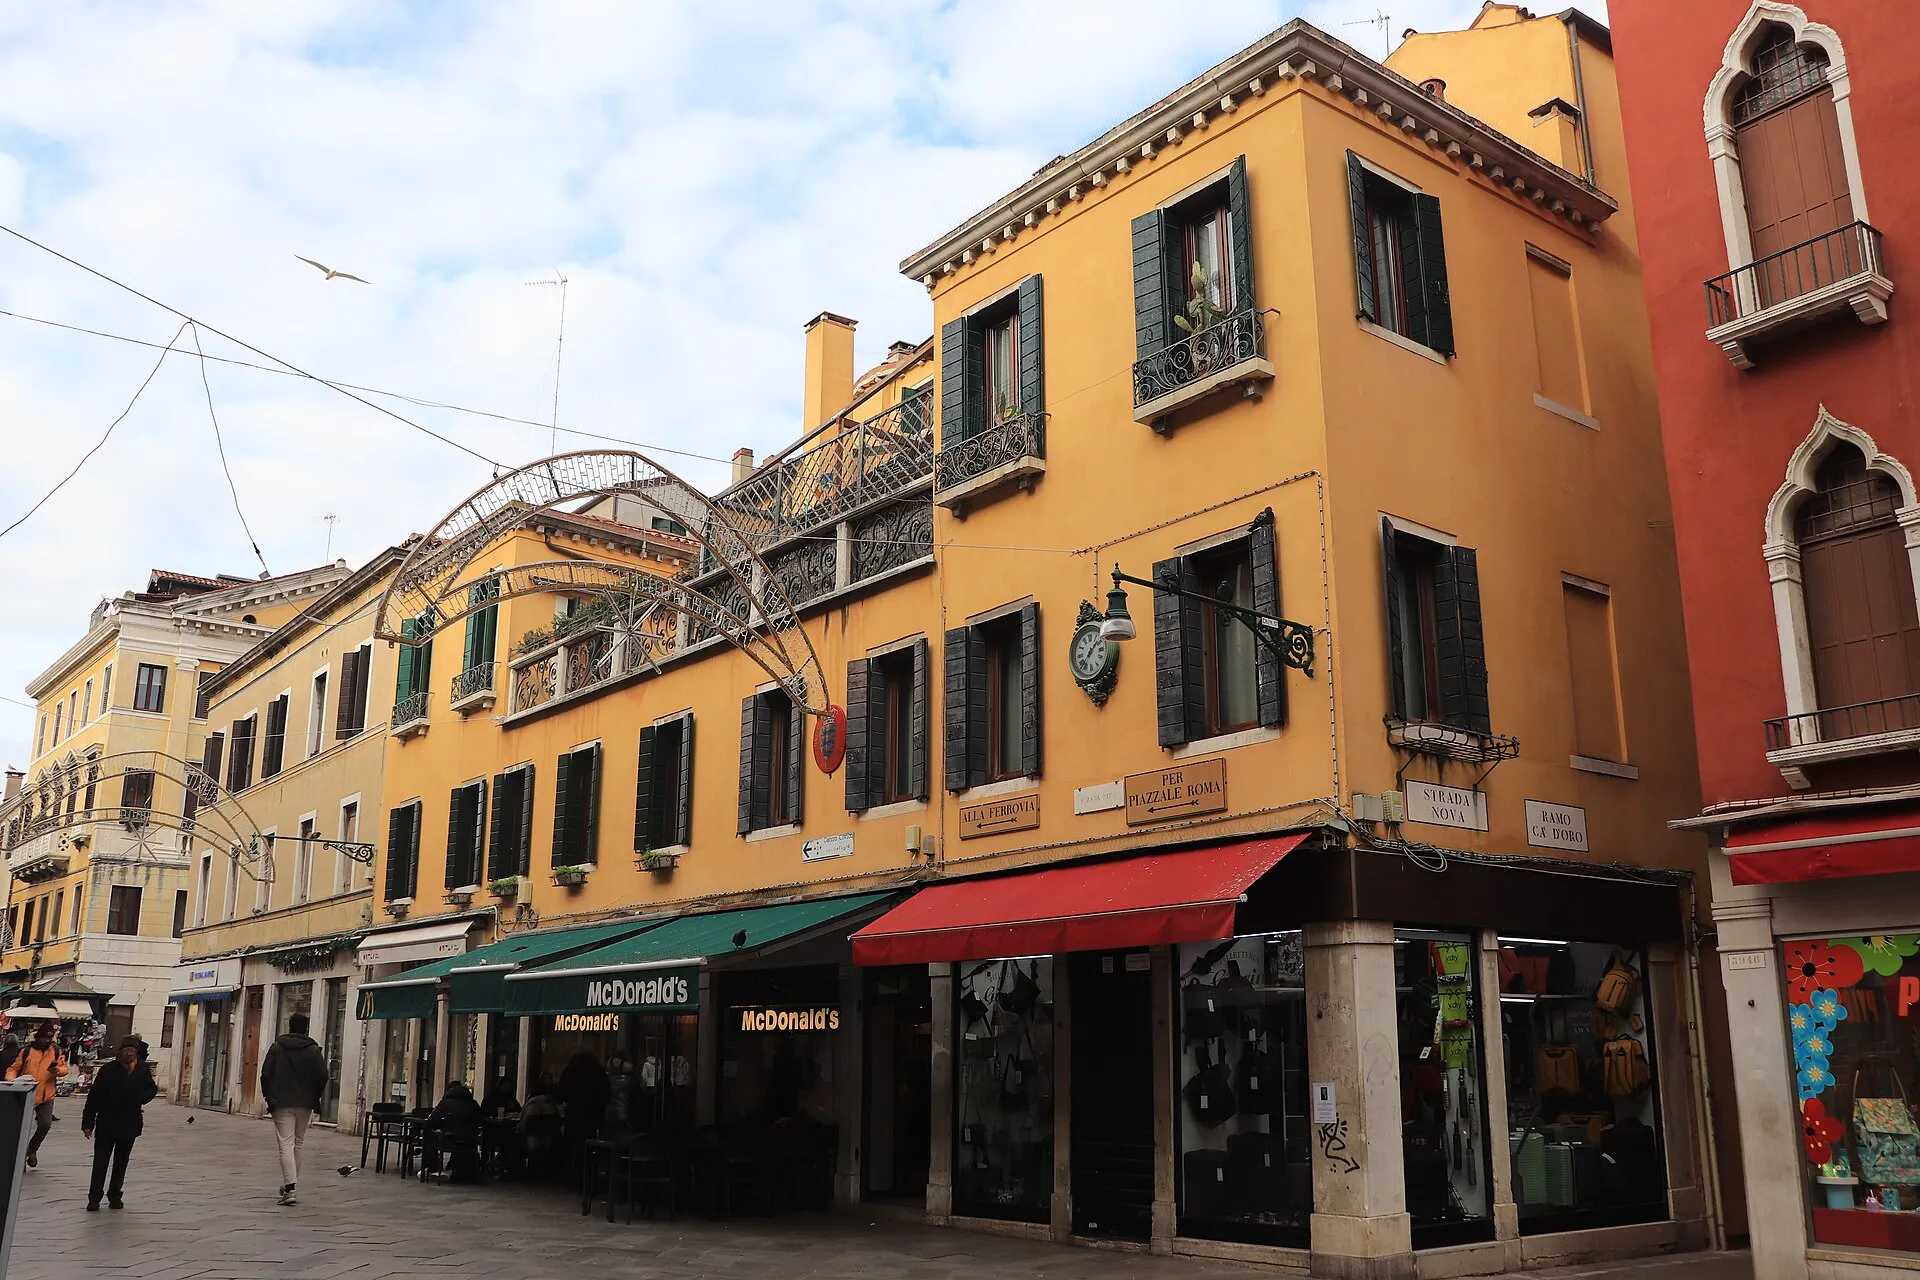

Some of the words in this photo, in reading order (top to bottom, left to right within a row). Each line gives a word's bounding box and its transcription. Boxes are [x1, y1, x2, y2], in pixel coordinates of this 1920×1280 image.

[1162, 771, 1184, 787] PER
[1129, 786, 1182, 808] PIAZZALE
[1187, 780, 1221, 798] ROMA
[1423, 788, 1471, 807] STRADA
[962, 809, 985, 824] ALLA
[989, 800, 1036, 819] FERROVIA
[1431, 806, 1466, 824] NOVA
[1541, 810, 1572, 827] RAMO
[1552, 828, 1584, 844] D'ORO
[587, 976, 688, 1007] McDonald's
[554, 1013, 619, 1032] McDonald's
[741, 1007, 840, 1031] McDonald's
